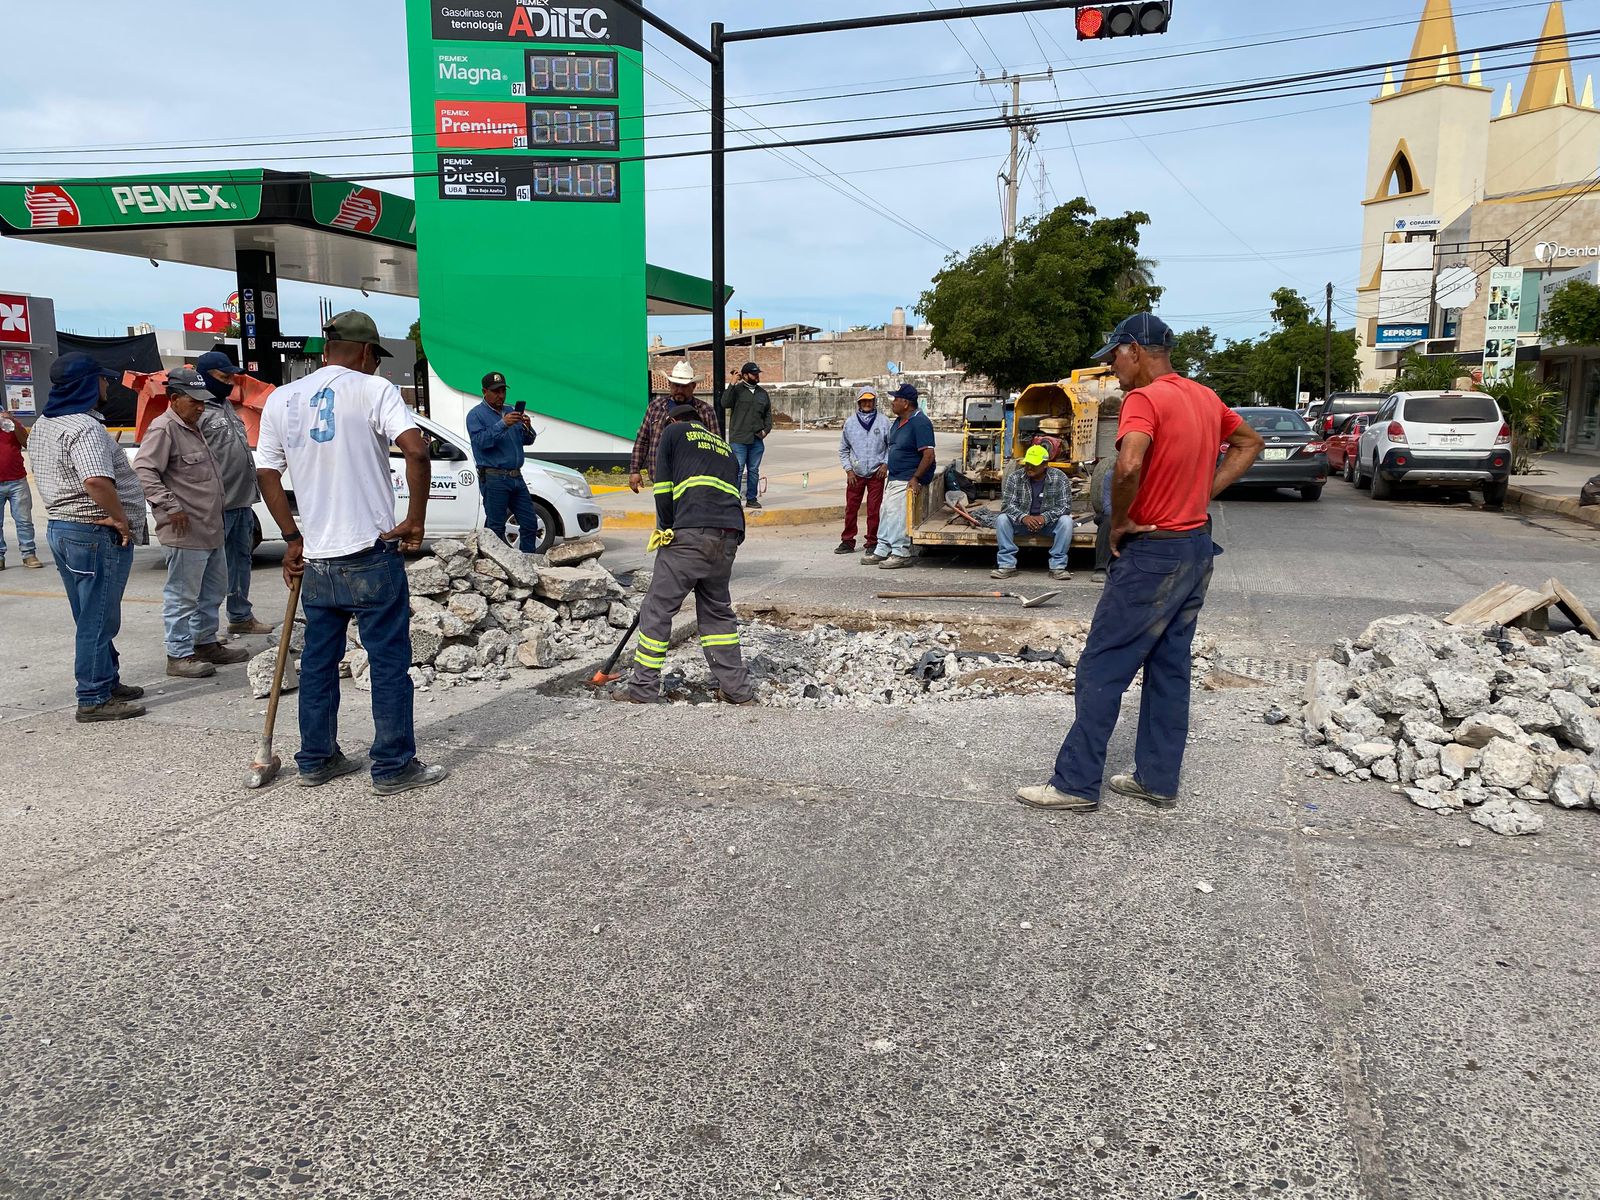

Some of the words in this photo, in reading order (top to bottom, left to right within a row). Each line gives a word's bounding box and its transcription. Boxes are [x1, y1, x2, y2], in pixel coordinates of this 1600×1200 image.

[441, 7, 485, 18] Gasolinas
[486, 10, 503, 18] con
[451, 19, 504, 32] tecnología
[439, 55, 469, 63] PEMEX
[439, 62, 502, 85] Magna
[512, 83, 522, 95] 87
[441, 109, 470, 117] PEMEX
[441, 116, 519, 135] Premium
[443, 158, 473, 166] PEMEX
[443, 166, 500, 184] Diesel
[111, 185, 231, 214] PEMEX
[517, 188, 527, 200] 45
[1492, 270, 1521, 280] ESTILO
[272, 341, 301, 349] PEMEX
[310, 387, 336, 443] 3
[460, 472, 472, 484] 189
[430, 481, 457, 489] SAVE
